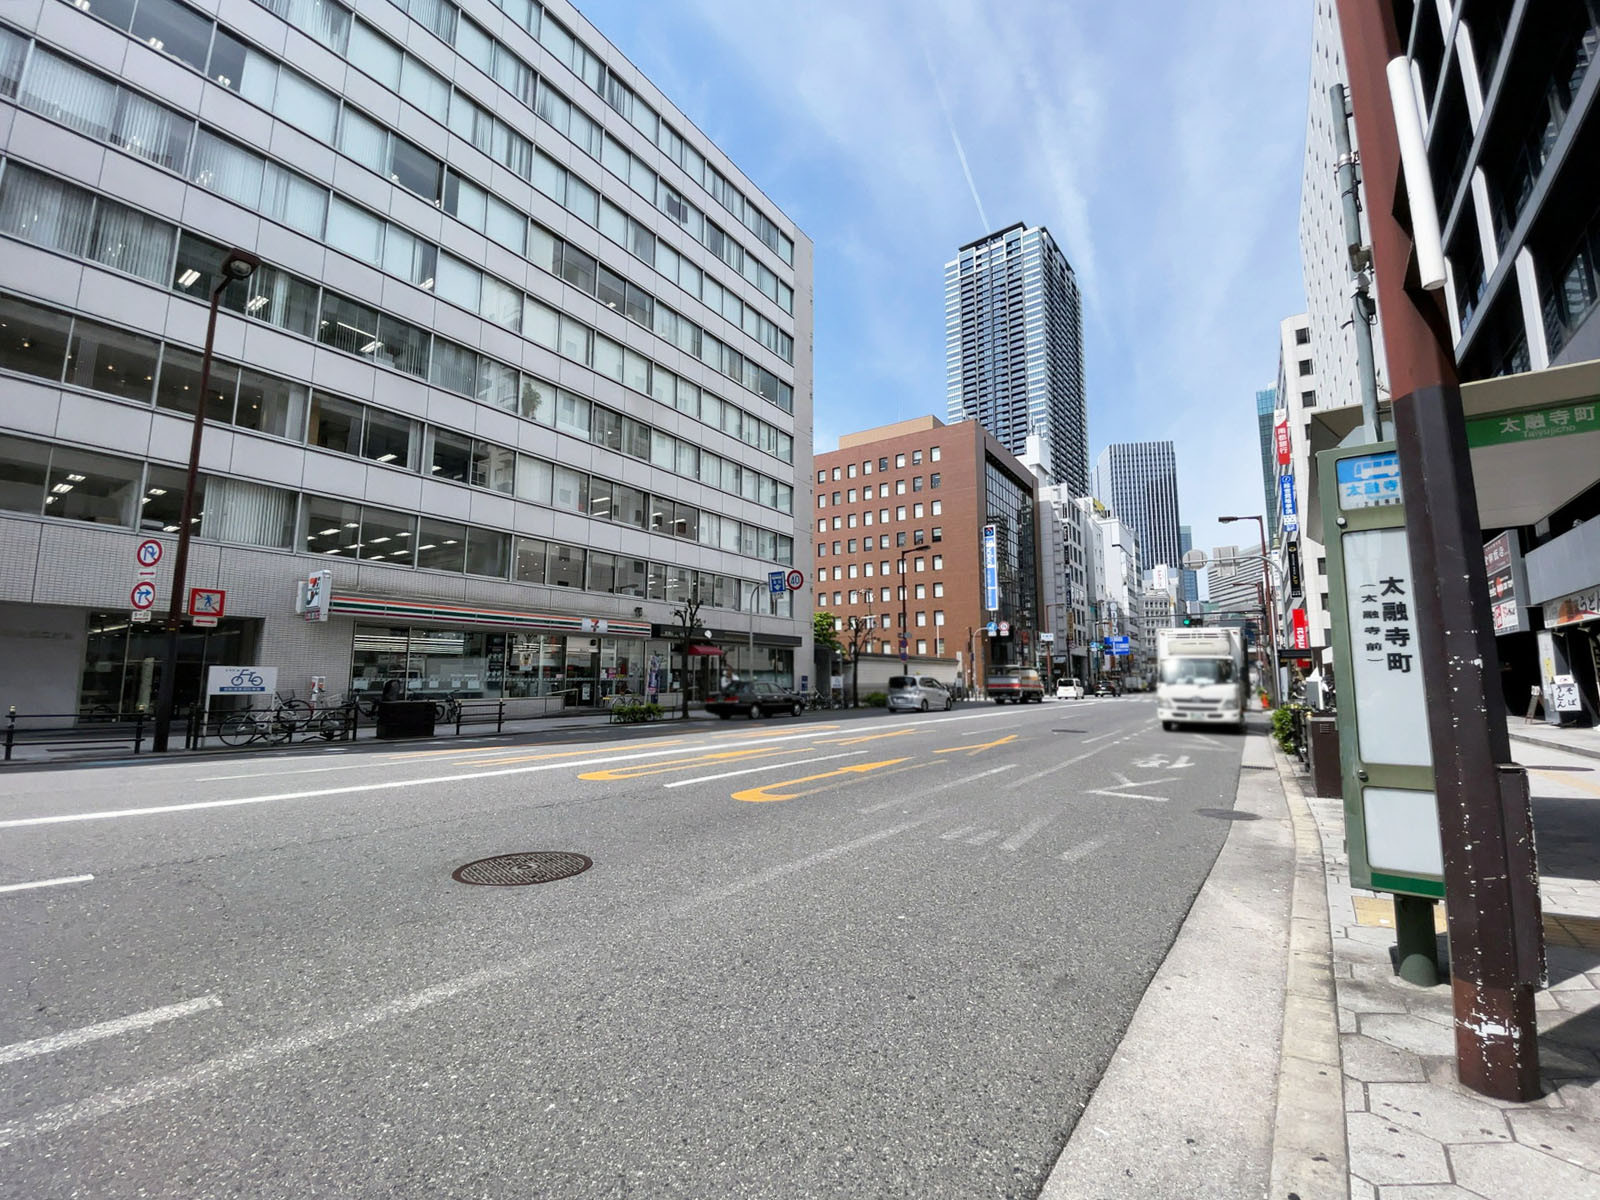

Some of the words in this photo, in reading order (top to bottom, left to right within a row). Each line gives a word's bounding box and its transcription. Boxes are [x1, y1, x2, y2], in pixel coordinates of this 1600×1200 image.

[1499, 406, 1595, 433] 太融寺町
[790, 574, 800, 586] 40
[1379, 576, 1413, 673] 太融寺町
